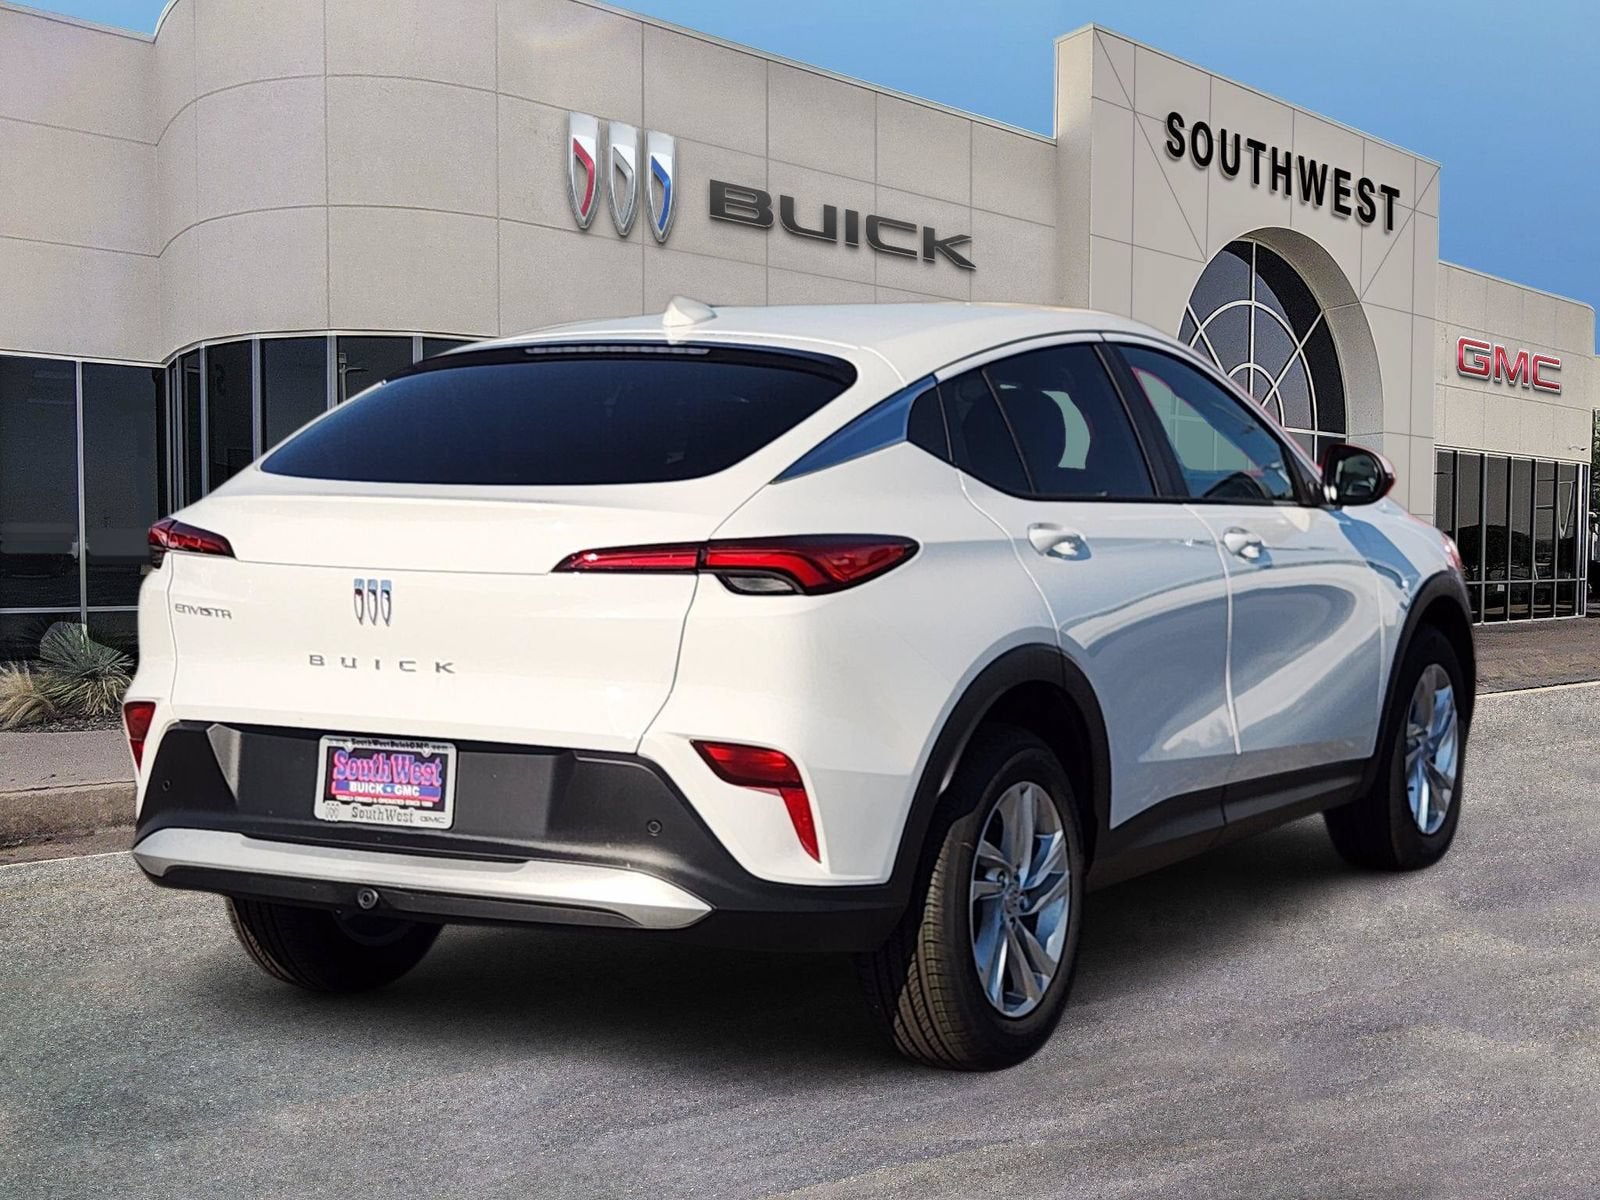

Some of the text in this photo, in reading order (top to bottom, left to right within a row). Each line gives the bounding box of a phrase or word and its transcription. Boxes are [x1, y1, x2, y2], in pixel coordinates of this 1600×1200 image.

[1166, 111, 1400, 232] SOUTHWEST
[709, 179, 977, 271] BUICK
[1457, 336, 1561, 395] GMC
[309, 654, 456, 674] BUICK
[349, 781, 420, 797] BUICK GMC
